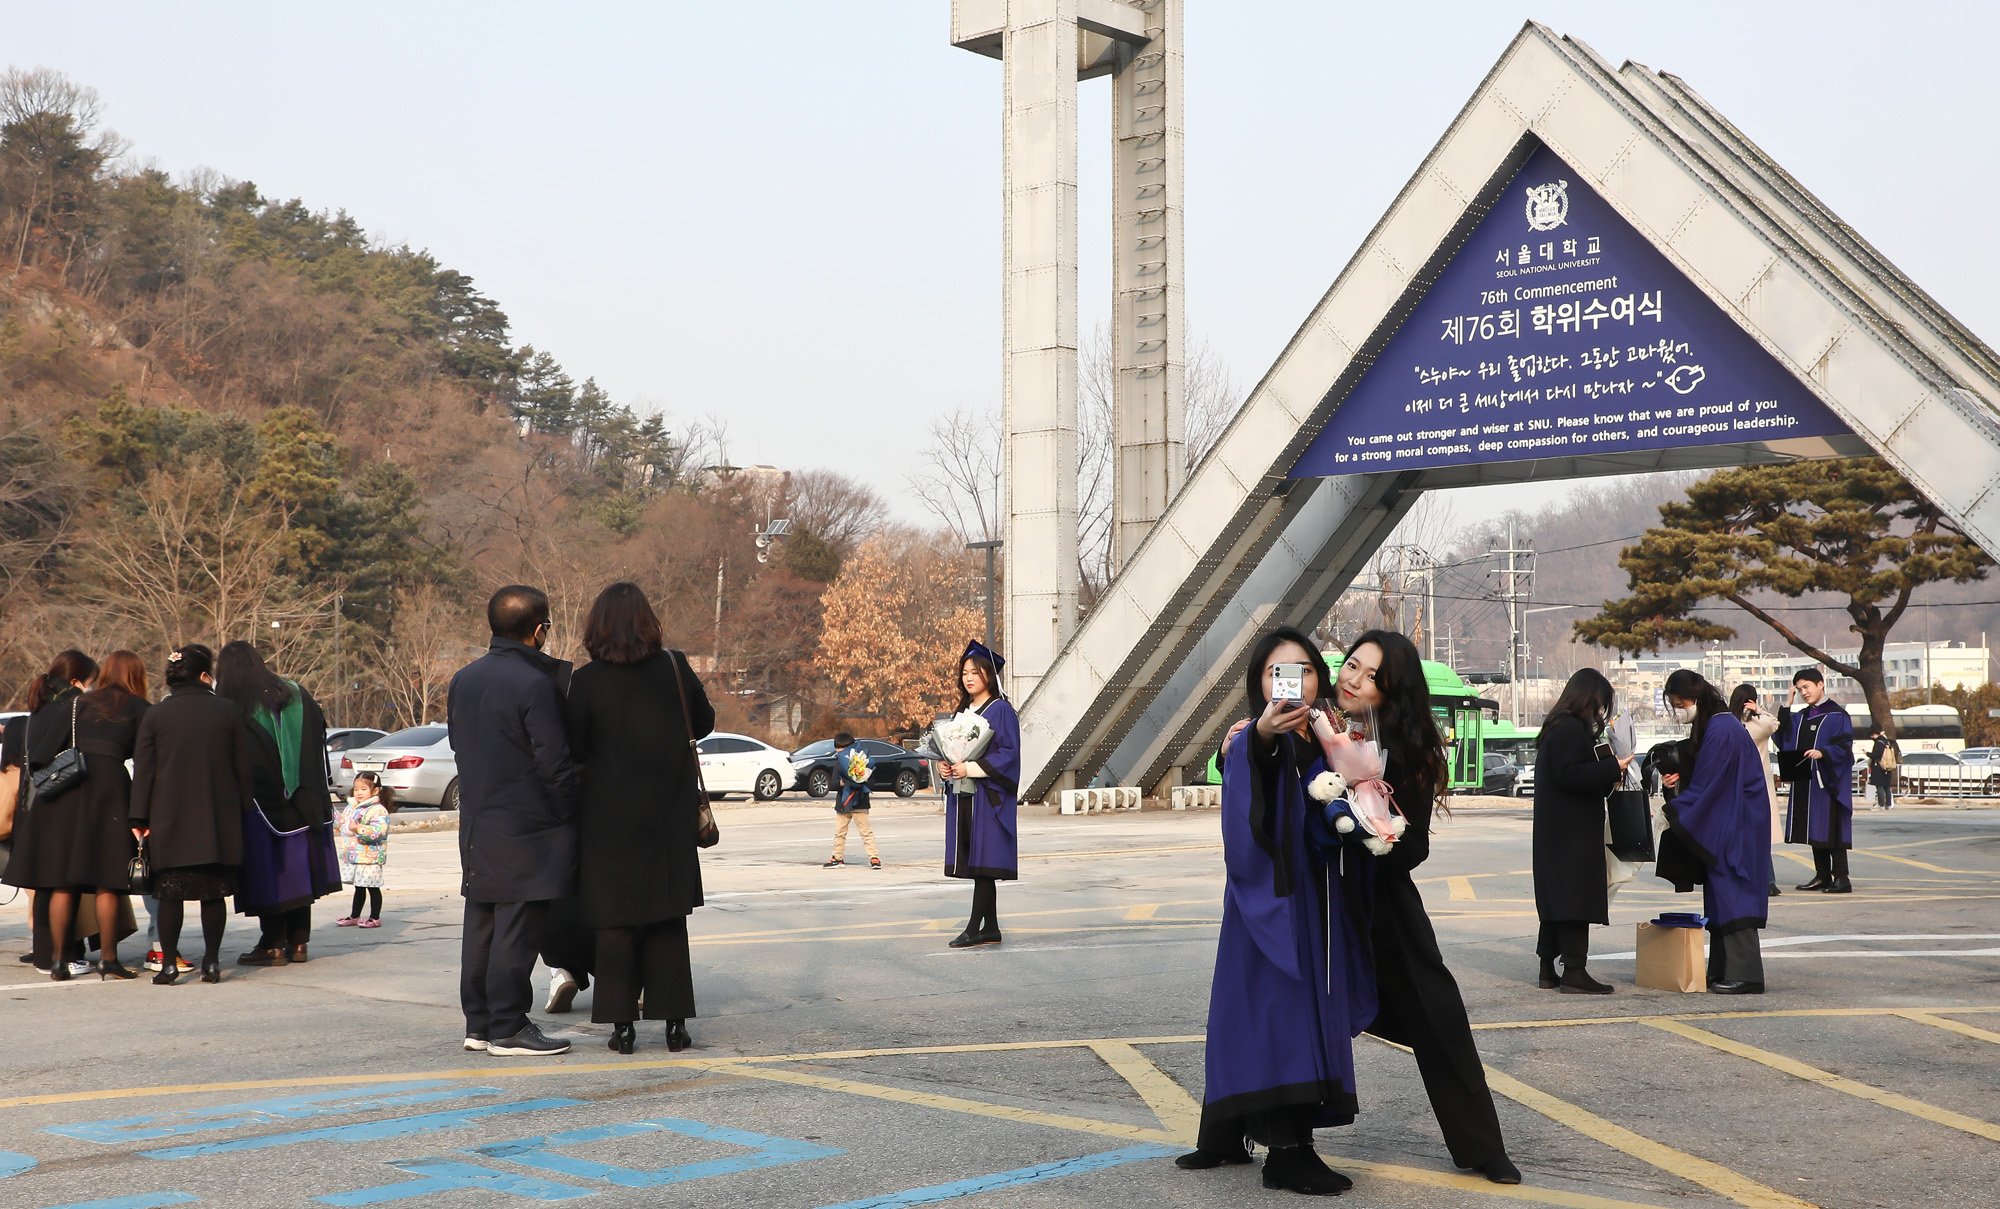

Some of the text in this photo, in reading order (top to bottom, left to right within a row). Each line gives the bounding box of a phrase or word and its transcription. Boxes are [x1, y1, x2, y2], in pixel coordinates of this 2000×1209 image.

[1496, 257, 1600, 278] SEOUL NATIONAL UNIVERSITY
[1480, 276, 1618, 305] 76th Commencement
[1440, 290, 1662, 345] 제76회 학위수여식
[1478, 362, 1500, 380] 우리
[1507, 354, 1572, 383] 졸업한다.
[1580, 346, 1620, 370] 그동안
[1627, 338, 1693, 364] 고마웠어.
[1405, 398, 1432, 414] 이제
[1438, 398, 1452, 410] 더
[1459, 392, 1470, 413] 큰
[1474, 388, 1539, 409] 세상에서
[1546, 383, 1576, 400] 다시
[1334, 414, 1798, 463] for a strong moral compass, deep compassion for others, and courageous leadership.
[1347, 399, 1777, 446] You came out stronger and wiser at SNU. Please know that we are proud of you
